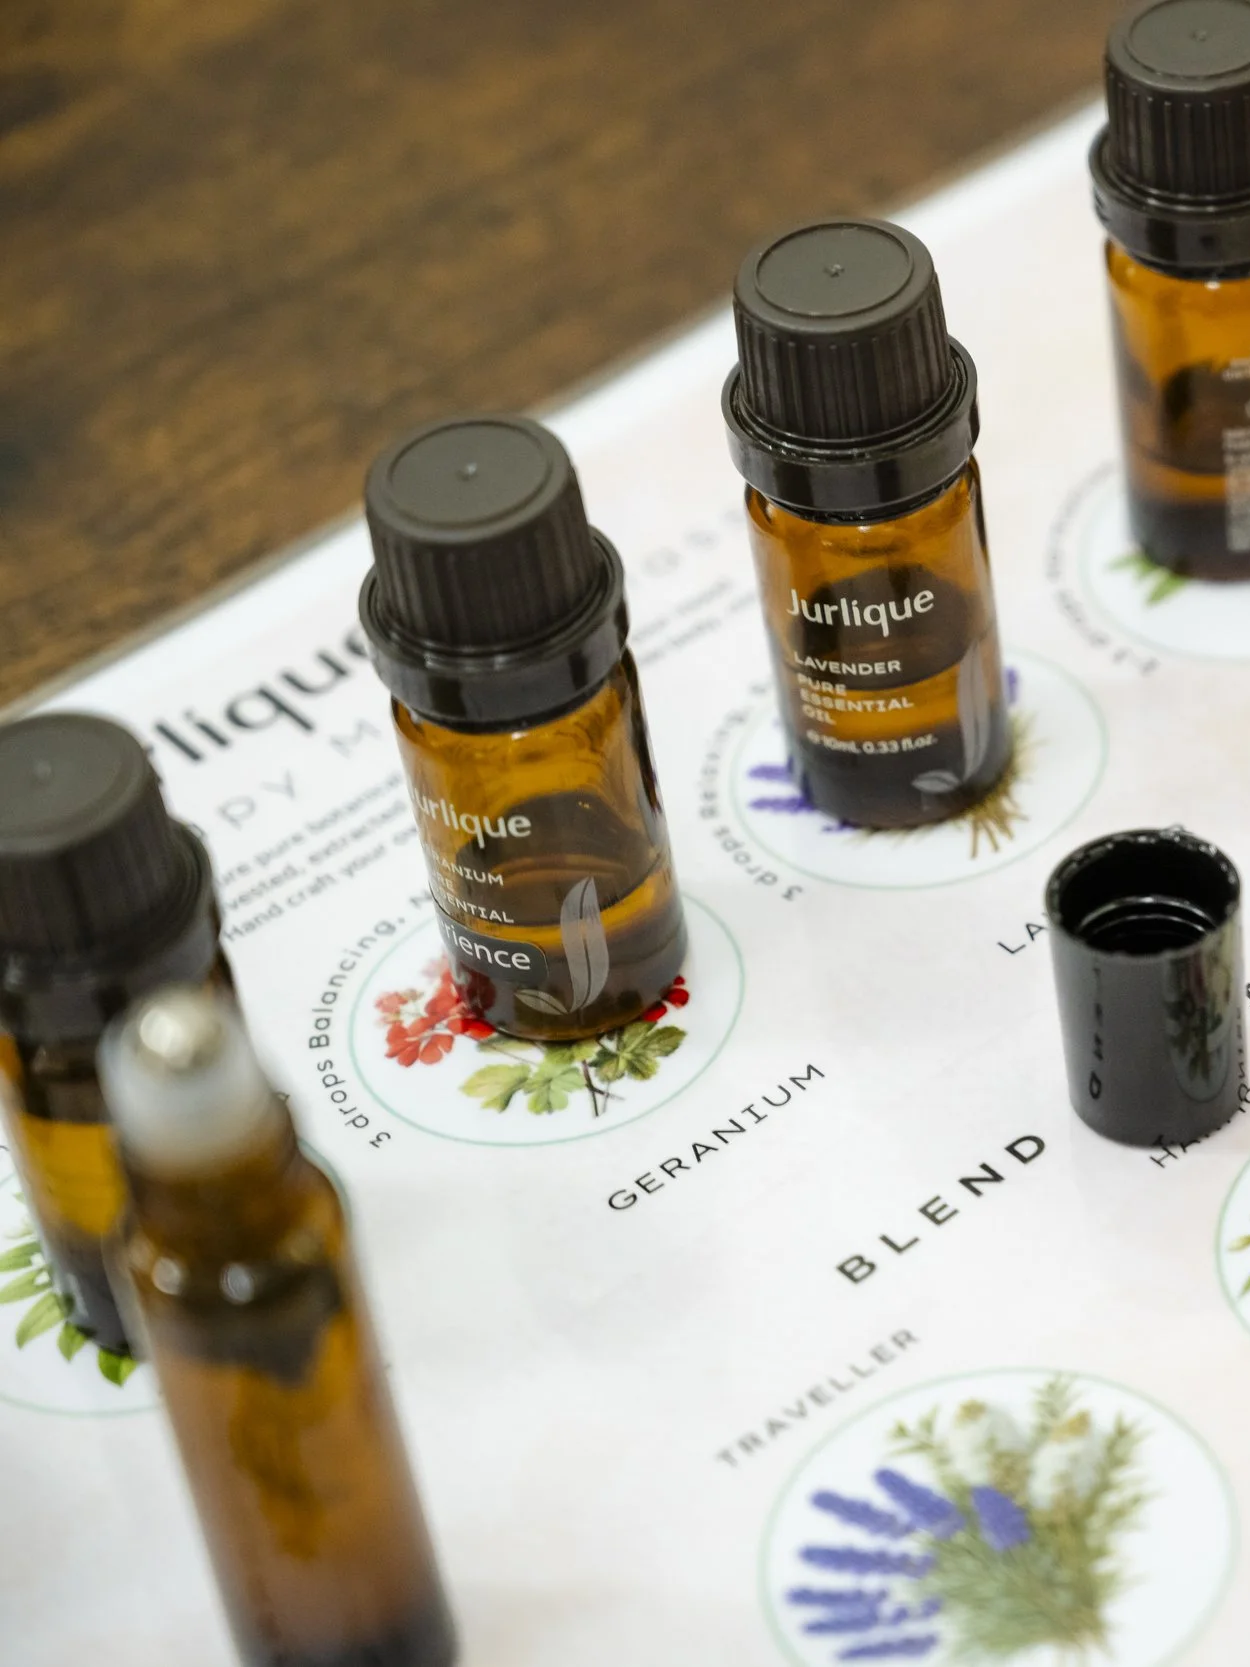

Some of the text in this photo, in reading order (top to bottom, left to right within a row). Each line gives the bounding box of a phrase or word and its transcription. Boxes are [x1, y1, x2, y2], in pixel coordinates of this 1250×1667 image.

[786, 588, 935, 638] Jurlique
[794, 652, 902, 676] LAVENDER
[797, 673, 847, 696] PURE
[152, 628, 370, 764] liqu
[800, 688, 914, 713] ESSENTIAL
[802, 704, 837, 725] OIL
[431, 850, 505, 888] RANIUM
[713, 825, 779, 887] drops
[223, 902, 285, 942] Hand
[288, 873, 337, 909] craft
[225, 863, 306, 915] vested,
[440, 892, 514, 924] ENTIAL
[441, 920, 531, 971] rience
[309, 916, 405, 1148] 3 drops Balancing,
[607, 1061, 826, 1213] GERANIUM
[836, 1133, 1047, 1286] BLEND
[715, 1328, 921, 1470] TRAVELLER
